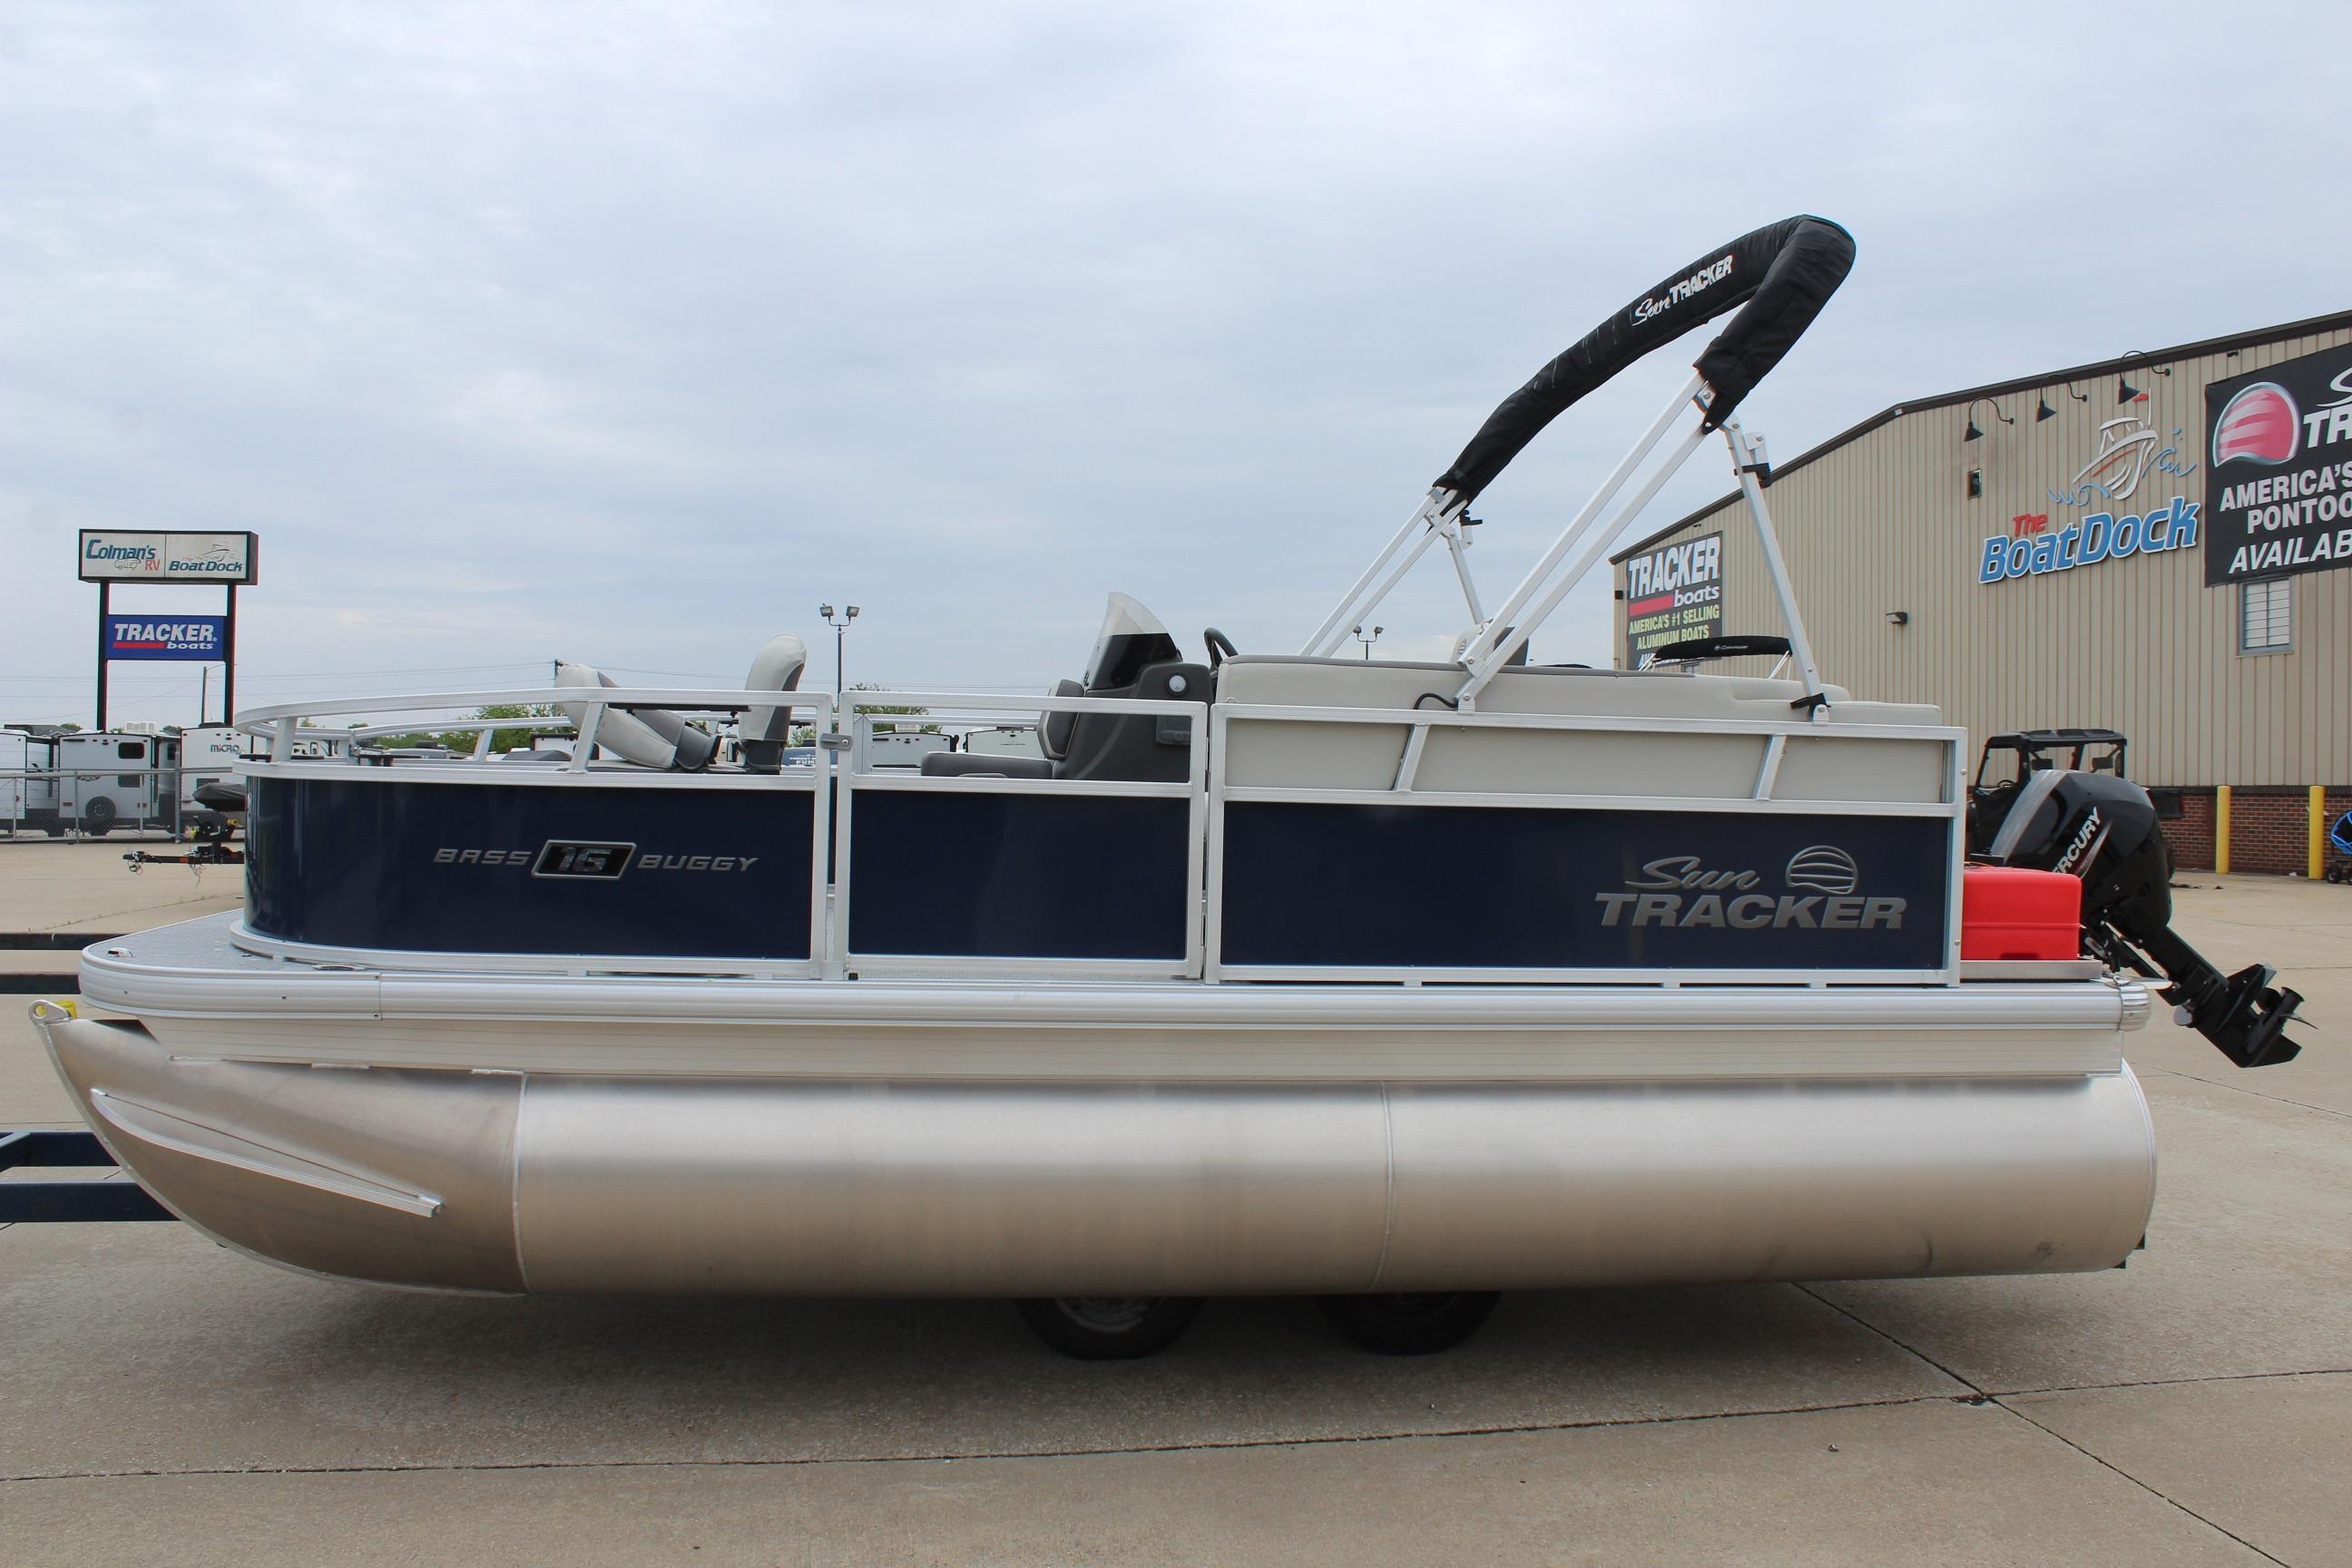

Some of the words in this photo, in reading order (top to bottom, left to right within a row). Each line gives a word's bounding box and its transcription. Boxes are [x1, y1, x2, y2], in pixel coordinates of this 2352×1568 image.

[1632, 298, 1671, 326] Sun
[1670, 255, 1733, 304] TRACKER
[2012, 513, 2048, 536] The
[85, 539, 156, 559] Colman's
[144, 559, 161, 571] RV
[1629, 536, 1720, 599] TRACKER
[1673, 584, 1720, 607] boats
[1629, 613, 1671, 635] AMERICA'S
[1671, 611, 1681, 627] #1
[1682, 603, 1720, 624] SELLING
[114, 623, 214, 641] TRACKER
[1637, 629, 1681, 651] ALUMINUM
[1681, 624, 1710, 642] BOATS
[166, 642, 214, 650] boats
[2053, 807, 2101, 874] RCURY
[434, 848, 533, 865] BASS
[637, 854, 759, 872] BUGGY
[1625, 856, 1760, 891] Sun
[1595, 893, 1907, 930] TRACKER
